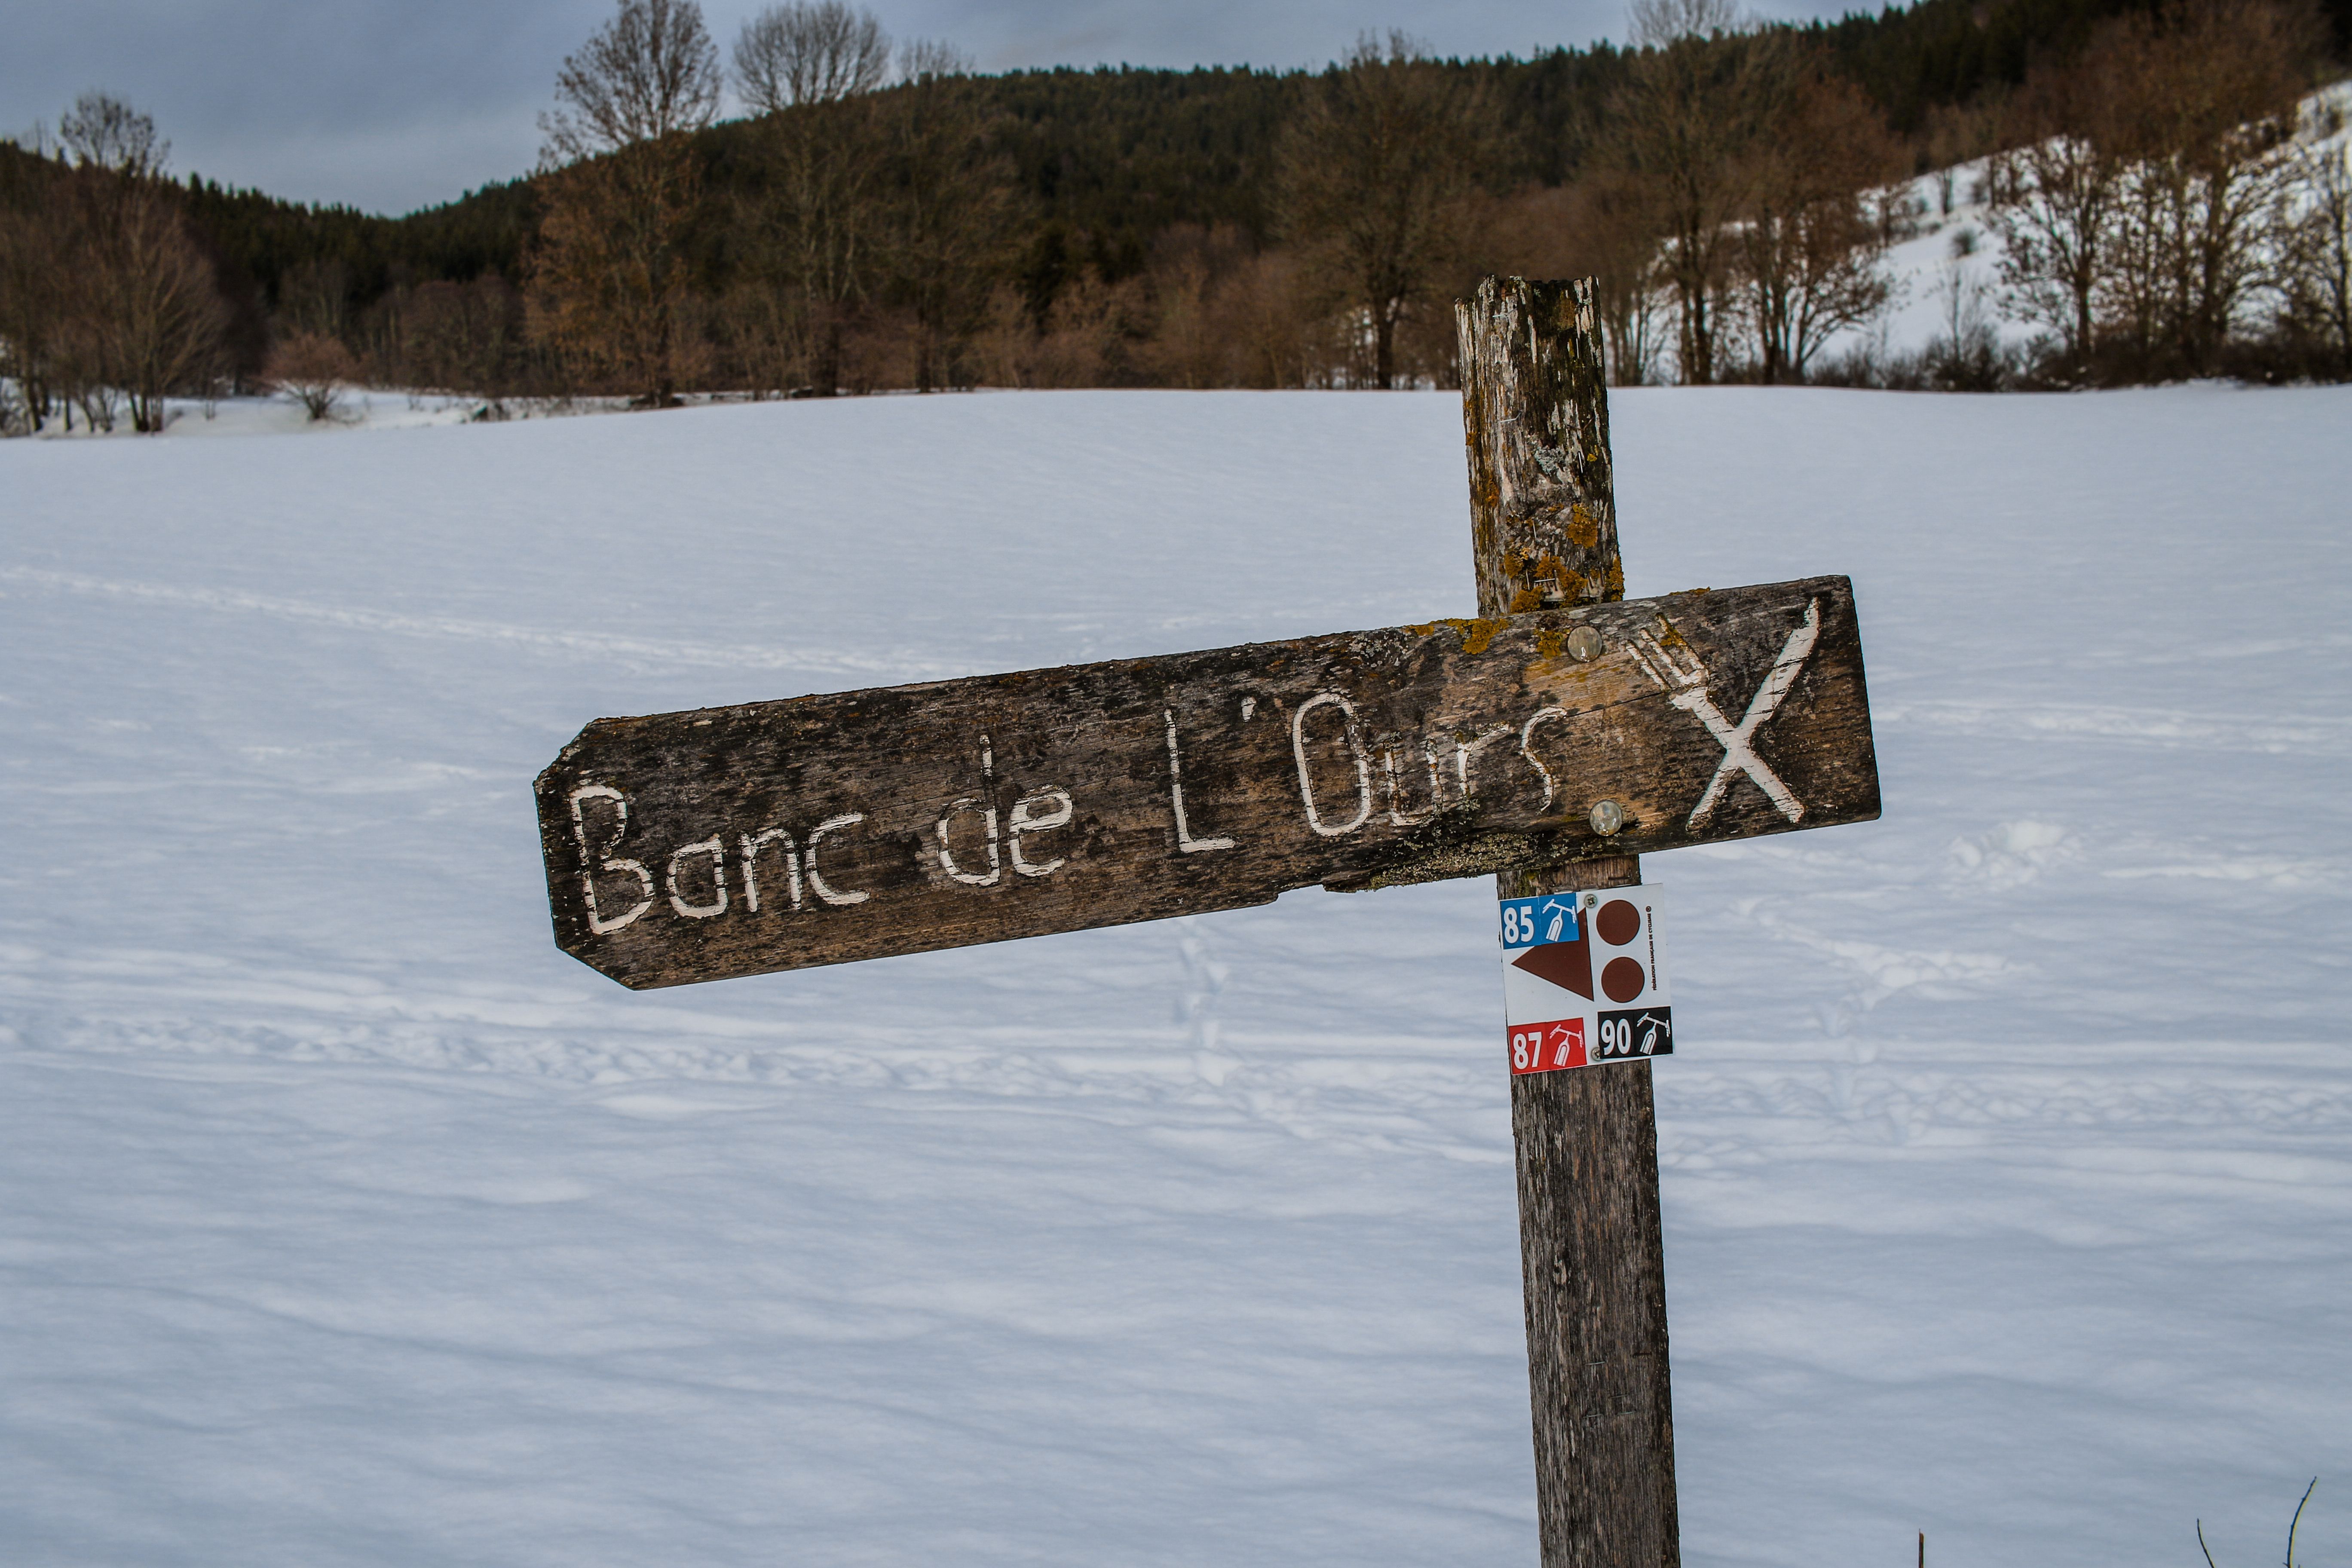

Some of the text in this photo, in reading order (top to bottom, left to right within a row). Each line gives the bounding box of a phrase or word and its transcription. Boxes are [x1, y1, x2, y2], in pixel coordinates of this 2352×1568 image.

[571, 784, 870, 934] Banc
[938, 735, 1073, 886] de
[1504, 906, 1534, 943] 85
[1513, 1032, 1542, 1069] 87
[1601, 1018, 1632, 1055] 90
